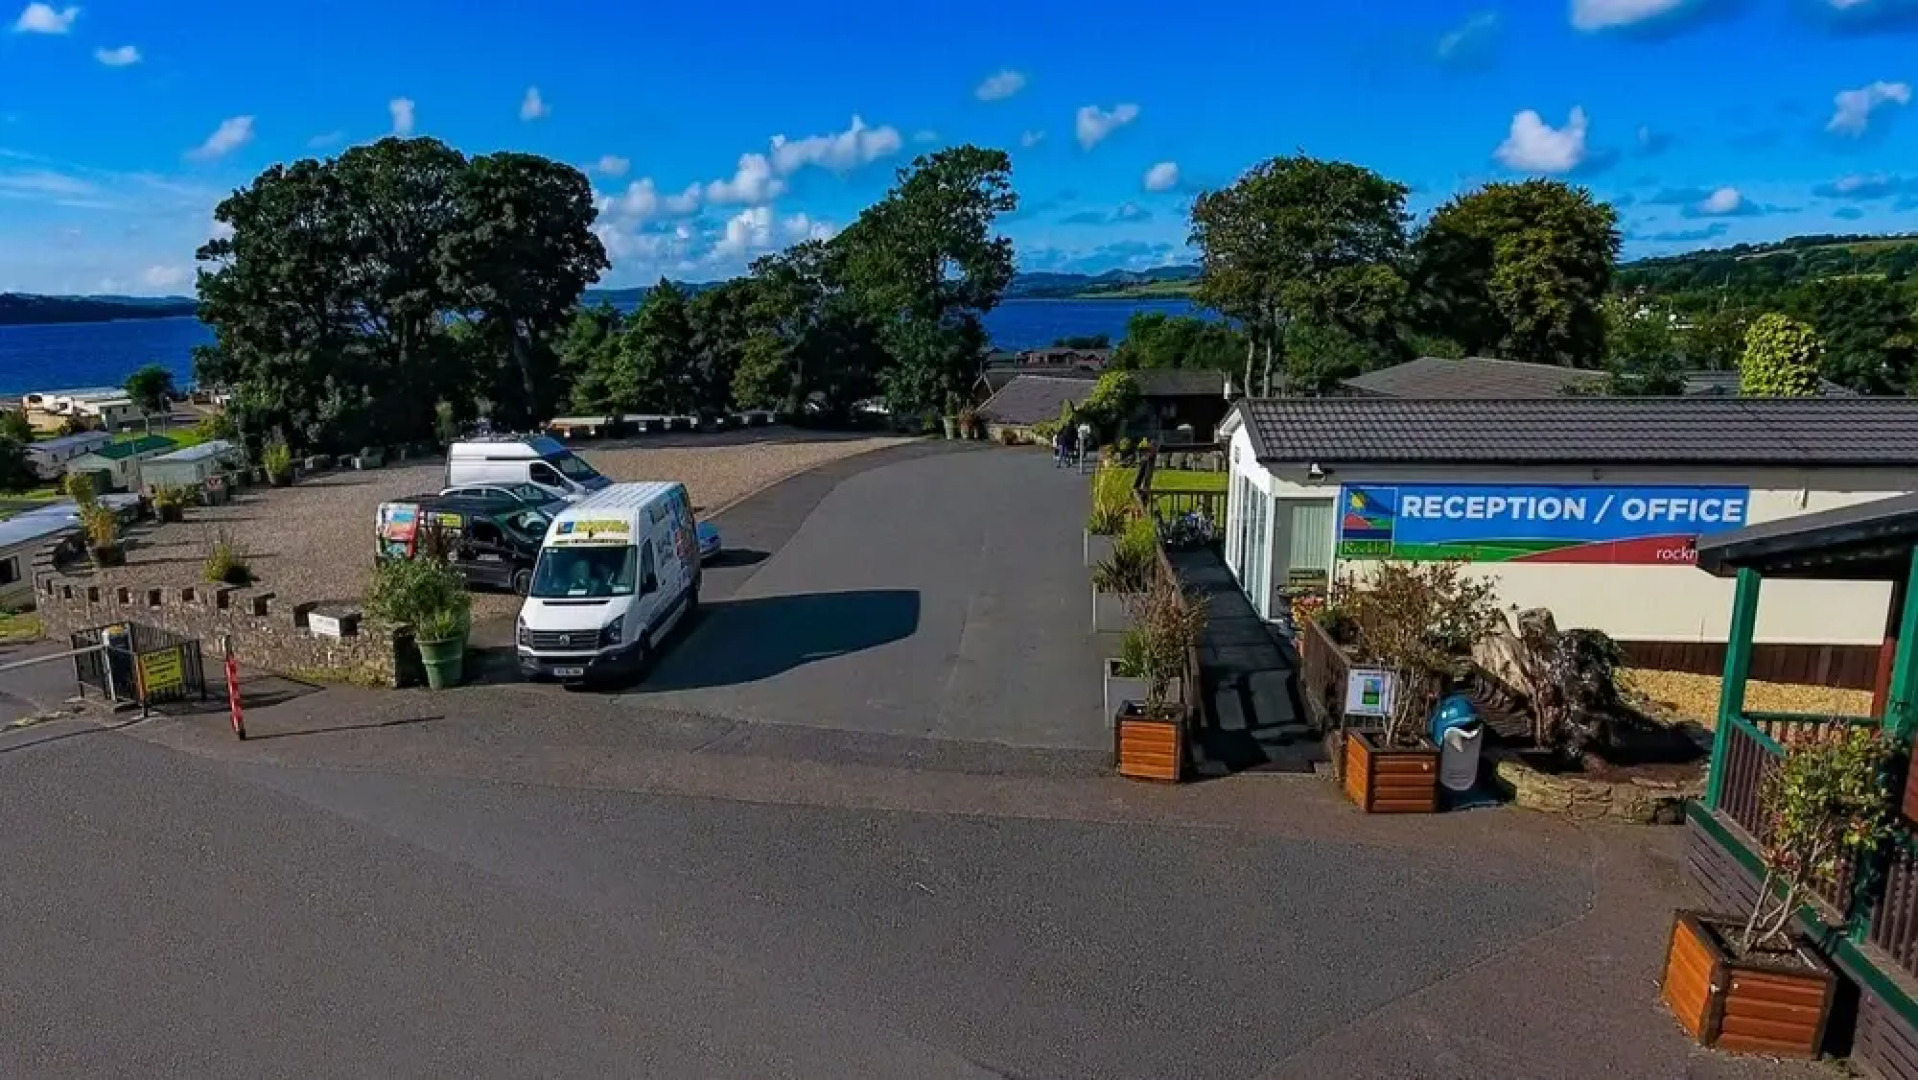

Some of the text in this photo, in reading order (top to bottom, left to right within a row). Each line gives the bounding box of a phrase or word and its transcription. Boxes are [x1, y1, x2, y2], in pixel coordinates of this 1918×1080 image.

[1401, 494, 1744, 524] RECEPTION / OFFICE
